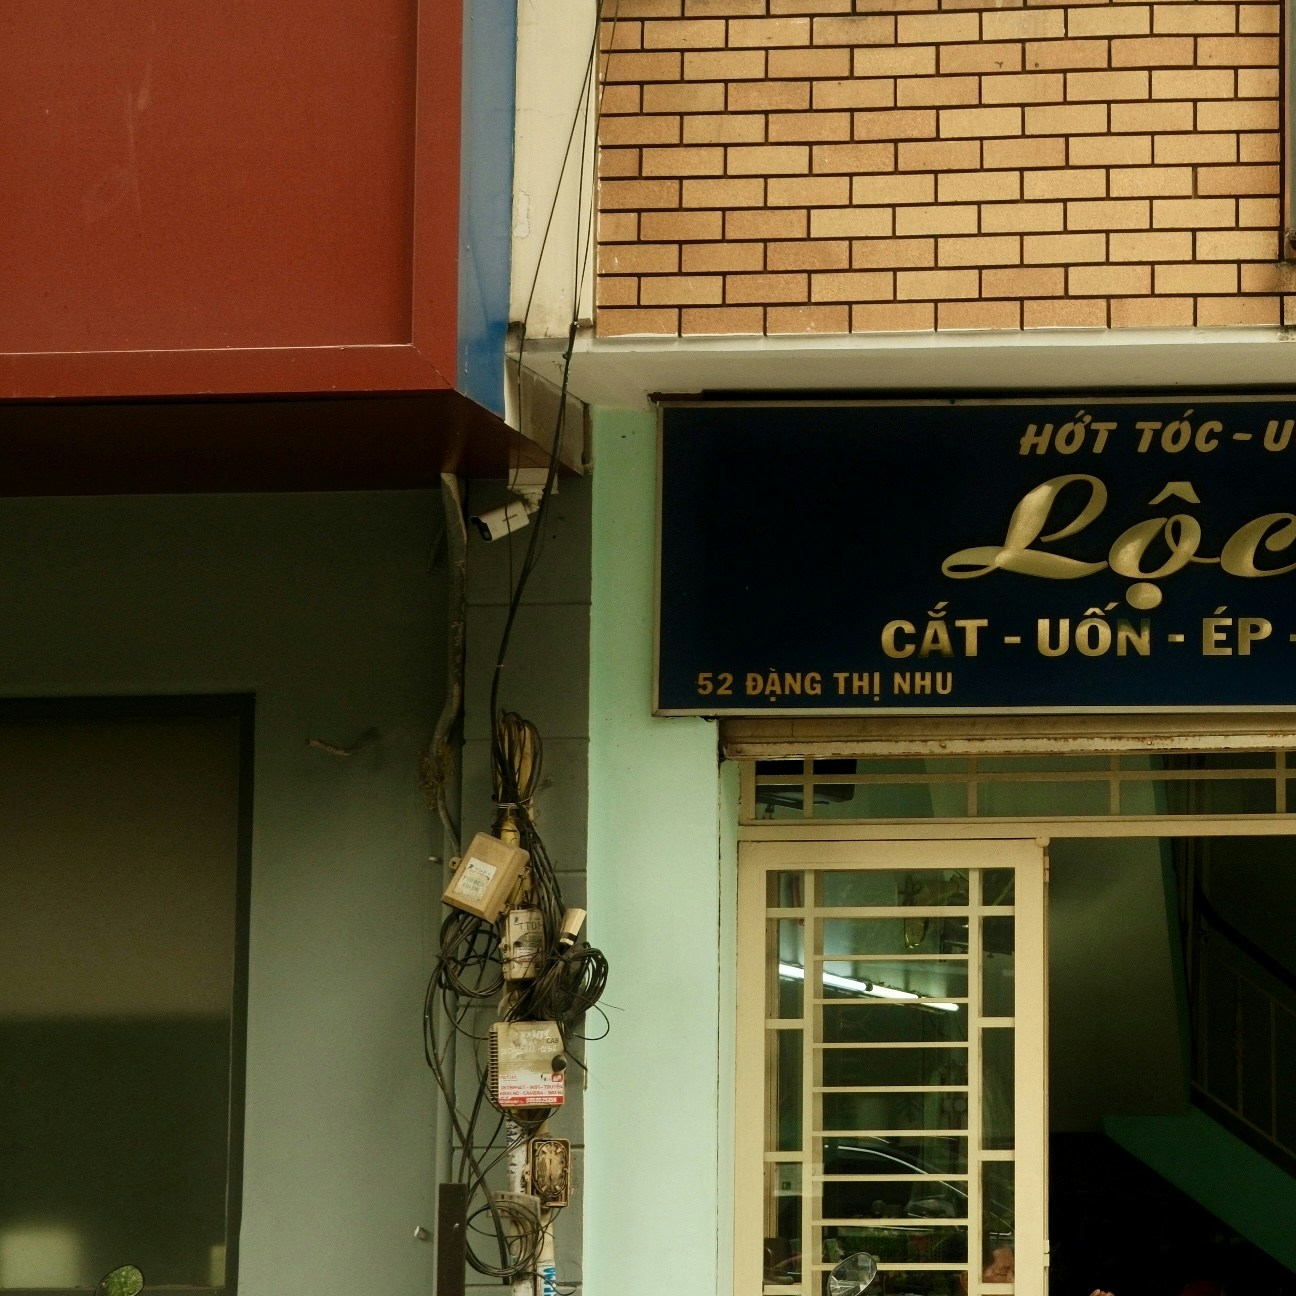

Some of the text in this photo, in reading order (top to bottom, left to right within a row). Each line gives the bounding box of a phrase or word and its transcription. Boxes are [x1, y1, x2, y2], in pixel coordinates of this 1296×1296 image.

[1019, 409, 1117, 455] HỚT
[1135, 408, 1222, 453] TÓC
[880, 601, 989, 659] CẮT
[1037, 602, 1151, 657] UỐN
[1202, 606, 1273, 656] ÉP
[697, 672, 734, 695] 52
[833, 671, 880, 702] THỊ
[893, 671, 953, 695] NHU
